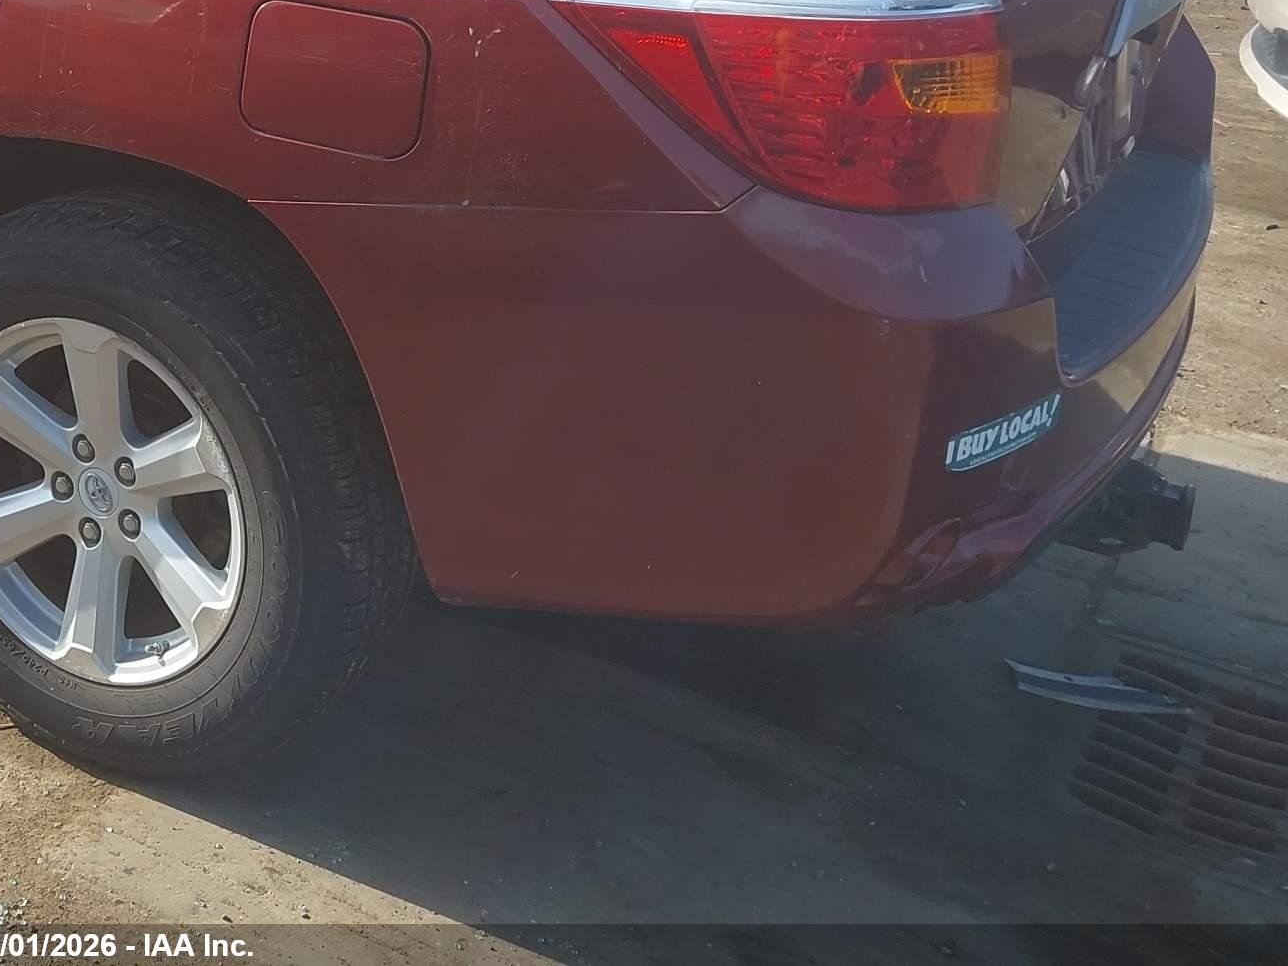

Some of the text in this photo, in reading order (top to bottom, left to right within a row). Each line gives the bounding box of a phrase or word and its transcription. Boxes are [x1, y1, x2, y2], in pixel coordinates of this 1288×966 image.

[945, 440, 956, 465] I
[956, 425, 1000, 462] BUY
[999, 394, 1061, 445] LOCAL!
